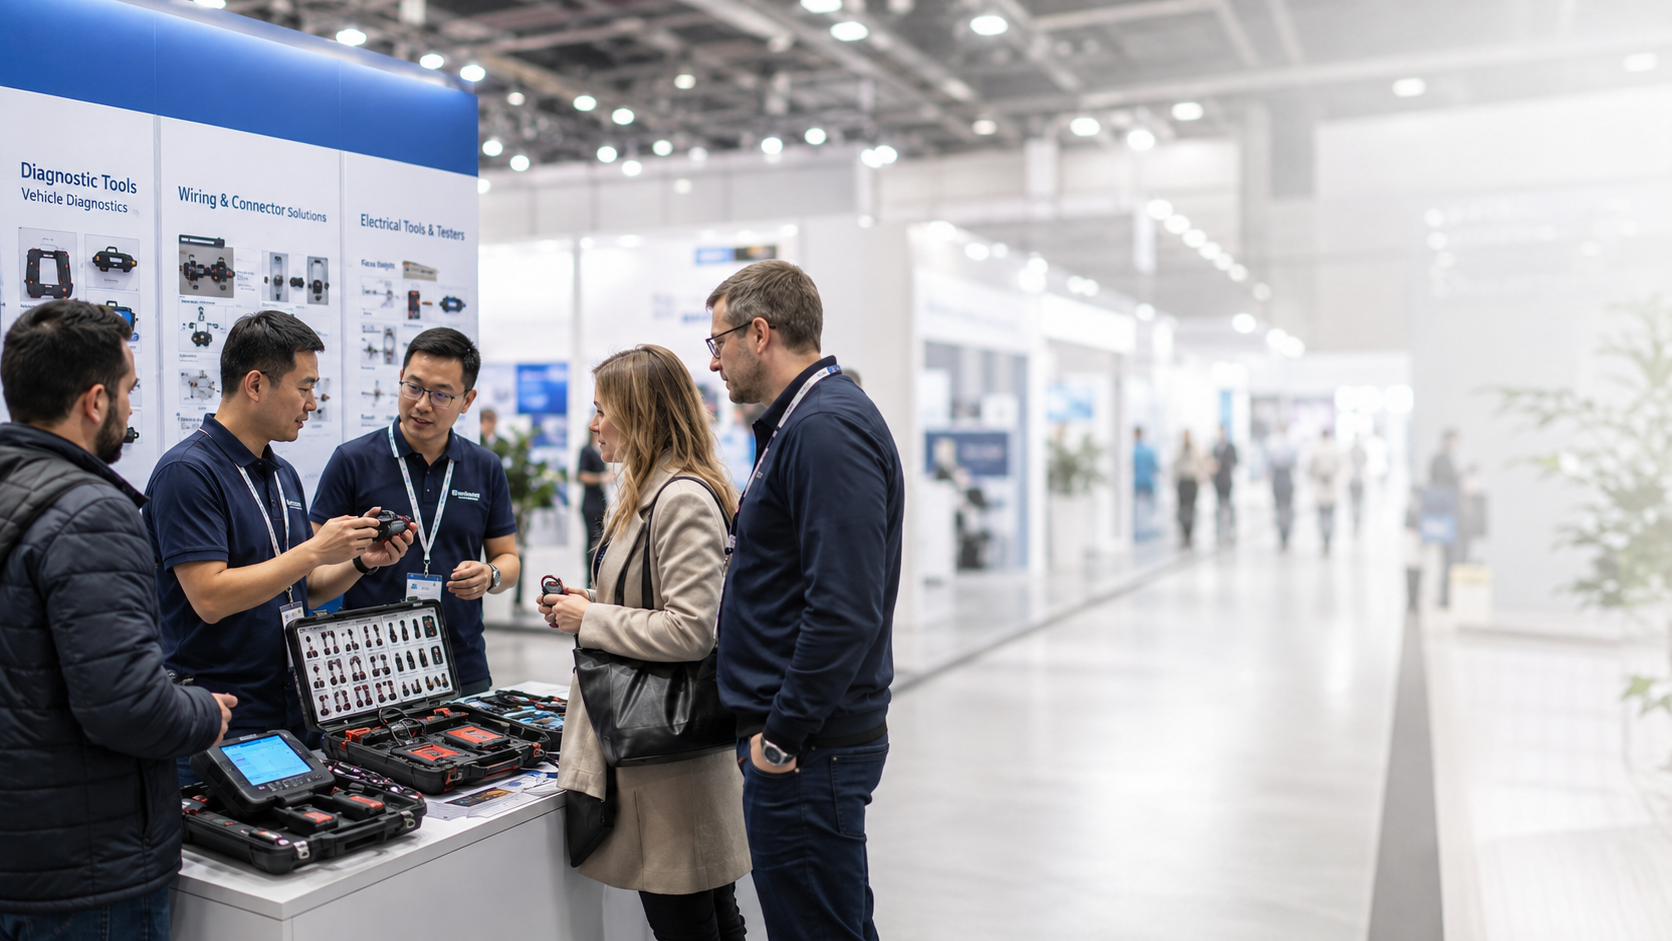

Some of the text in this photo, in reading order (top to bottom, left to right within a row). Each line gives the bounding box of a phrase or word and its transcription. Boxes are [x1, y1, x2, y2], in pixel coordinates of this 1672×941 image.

[21, 161, 138, 194] Diagnostic Tools
[21, 187, 129, 213] Vehicle Diagnostics
[178, 185, 327, 223] Wiring & Connector Solutions
[360, 213, 465, 241] Electrical Tools & Testers
